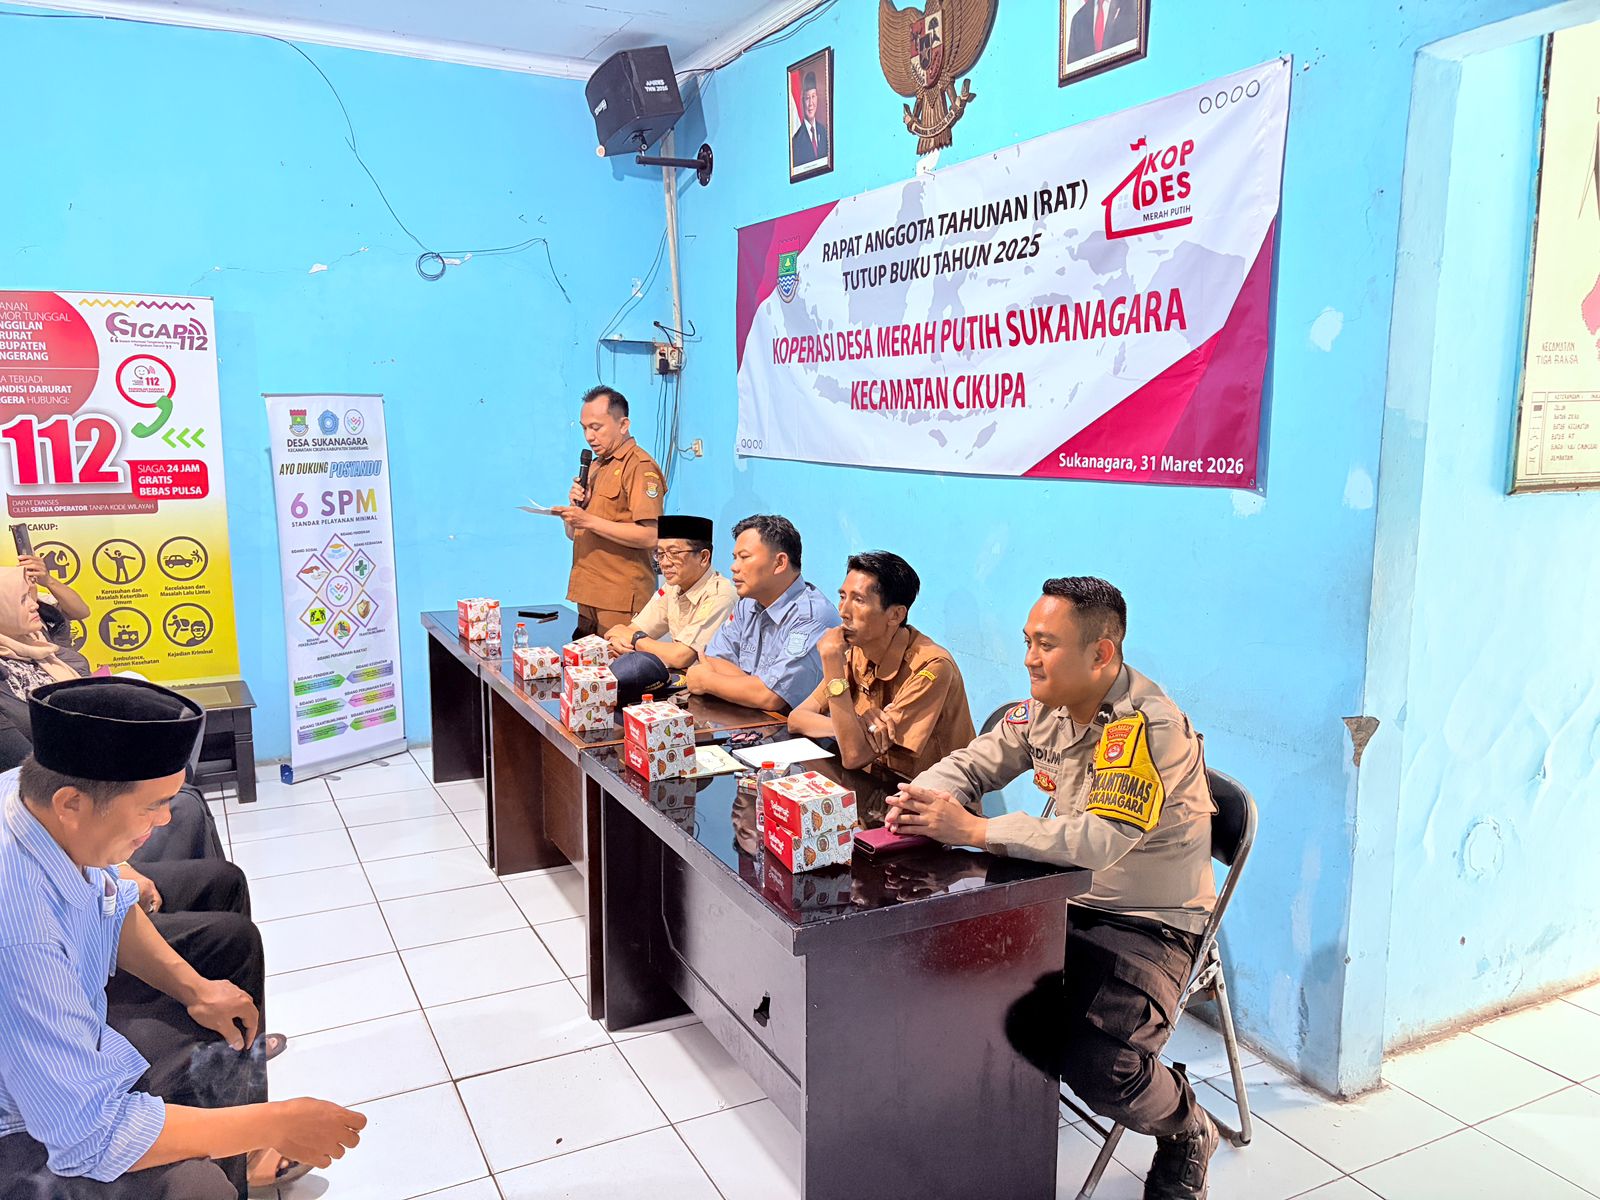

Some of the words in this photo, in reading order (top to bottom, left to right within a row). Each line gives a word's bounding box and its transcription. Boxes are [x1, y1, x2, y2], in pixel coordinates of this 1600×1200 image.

[1144, 139, 1195, 176] KOP
[1142, 171, 1192, 208] DES
[1142, 209, 1169, 222] MERAH
[1170, 205, 1192, 218] PUTIH
[822, 235, 862, 263] RAPAT
[866, 216, 936, 254] ANGGOTA
[938, 194, 1028, 235] TAHUNAN
[1033, 179, 1089, 220] (RAT)
[842, 266, 887, 292] TUTUP
[890, 257, 931, 284] BUKU
[933, 244, 990, 277] TAHUN
[994, 233, 1042, 263] 2025
[23, 312, 71, 322] TUNGGAL
[772, 332, 836, 365] KOPERASI
[837, 329, 874, 361] DESA
[877, 322, 937, 357] MERAH
[941, 312, 1002, 353] PUTIH
[1006, 288, 1187, 347] SUKANAGARA
[0, 341, 46, 350] BUPATEN
[179, 335, 208, 351] 112
[0, 352, 49, 360] NGERANG
[1536, 355, 1552, 364] TIGA
[1554, 354, 1578, 364] RAKSA
[8, 375, 43, 384] TERJADI
[145, 377, 160, 386] 112
[0, 385, 27, 393] NDISI
[29, 385, 72, 394] DARURAT
[850, 376, 949, 410] KECAMATAN
[953, 372, 1026, 409] CIKUPA
[0, 396, 25, 404] GERA
[27, 396, 70, 404] HUBUNGI:
[287, 438, 309, 448] DESA
[312, 437, 368, 447] SUKANAGARA
[2, 417, 120, 485] 112
[138, 464, 165, 473] SIAGA
[167, 464, 179, 473] 24
[180, 464, 200, 473] JAM
[1059, 452, 1138, 473] Sukanagara,
[1142, 456, 1157, 471] 31
[1160, 455, 1203, 473] Maret
[1206, 457, 1244, 475] 2026
[279, 463, 295, 475] AYO
[297, 462, 328, 475] DUKUNG
[329, 460, 382, 478] POSYANDU
[138, 475, 173, 485] GRATIS
[140, 487, 171, 496] BEBAS
[172, 486, 203, 495] PULSA
[127, 503, 154, 511] WILAYAH
[290, 493, 308, 519] 6
[321, 488, 377, 517] SPM
[321, 517, 355, 525] PELAYANAN
[8, 523, 58, 532] CAKUP:
